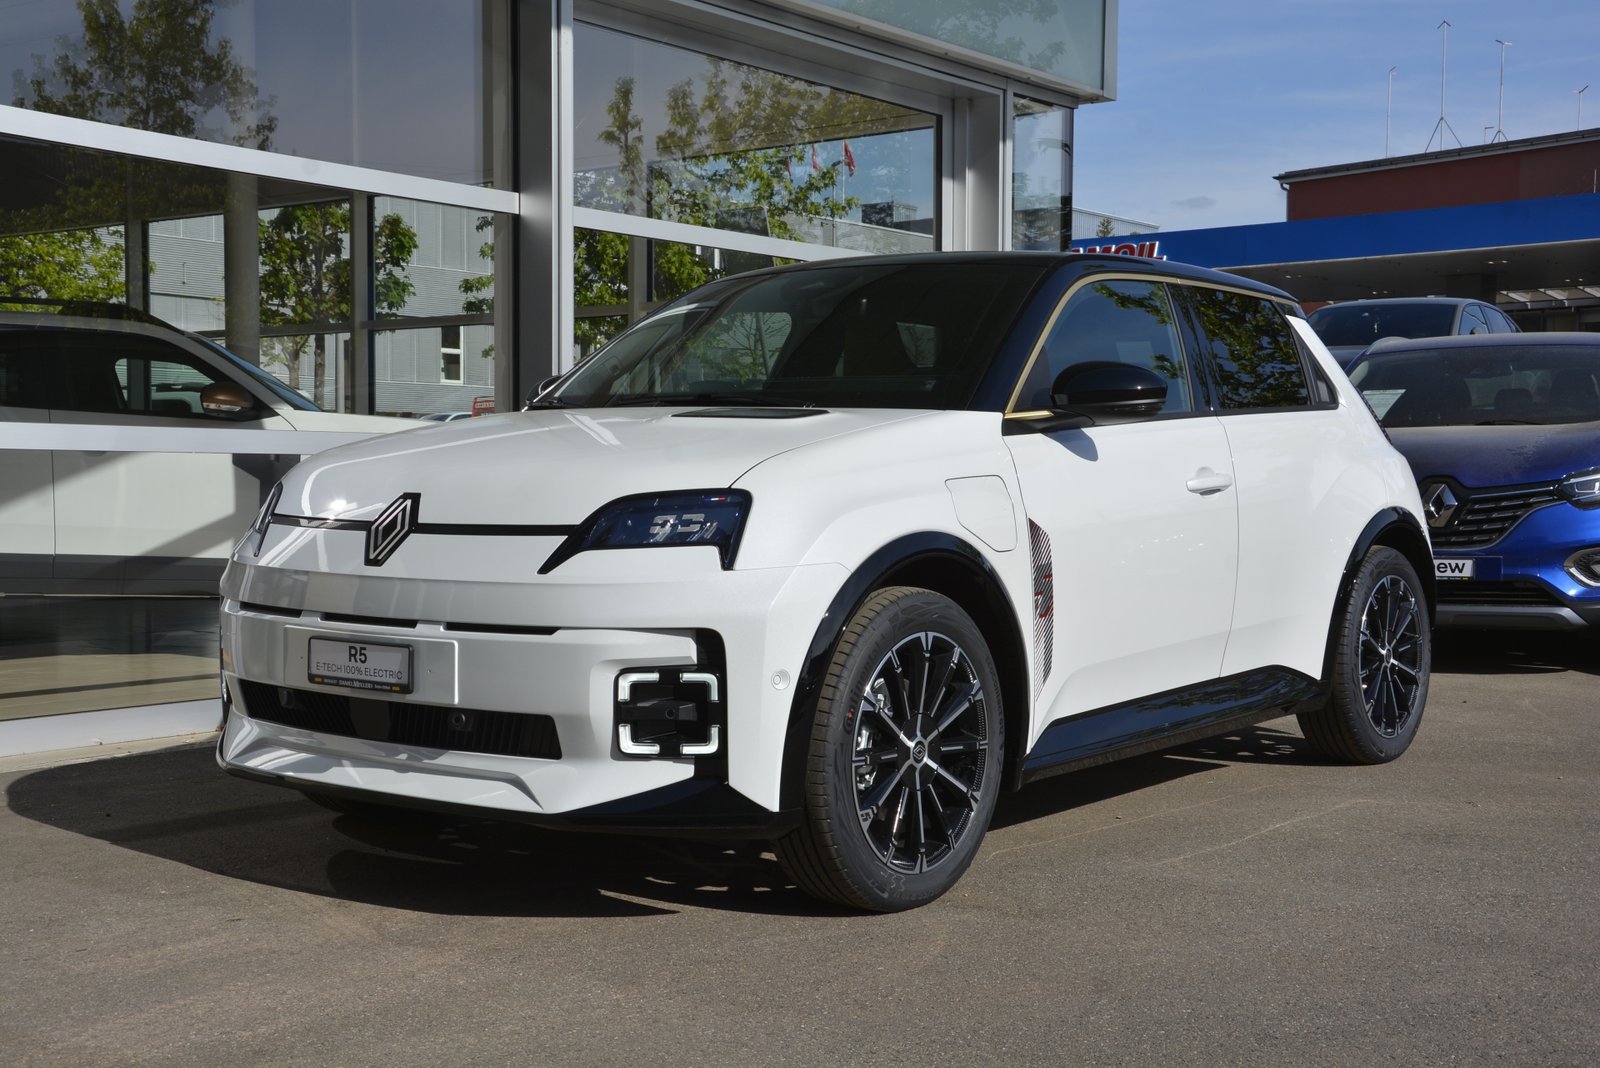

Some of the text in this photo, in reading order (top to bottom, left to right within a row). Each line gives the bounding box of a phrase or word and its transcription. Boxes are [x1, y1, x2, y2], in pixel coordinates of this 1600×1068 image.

[1436, 562, 1466, 574] ew
[348, 645, 368, 664] R5
[316, 661, 403, 680] E-TECH 100% ELECTRIC
